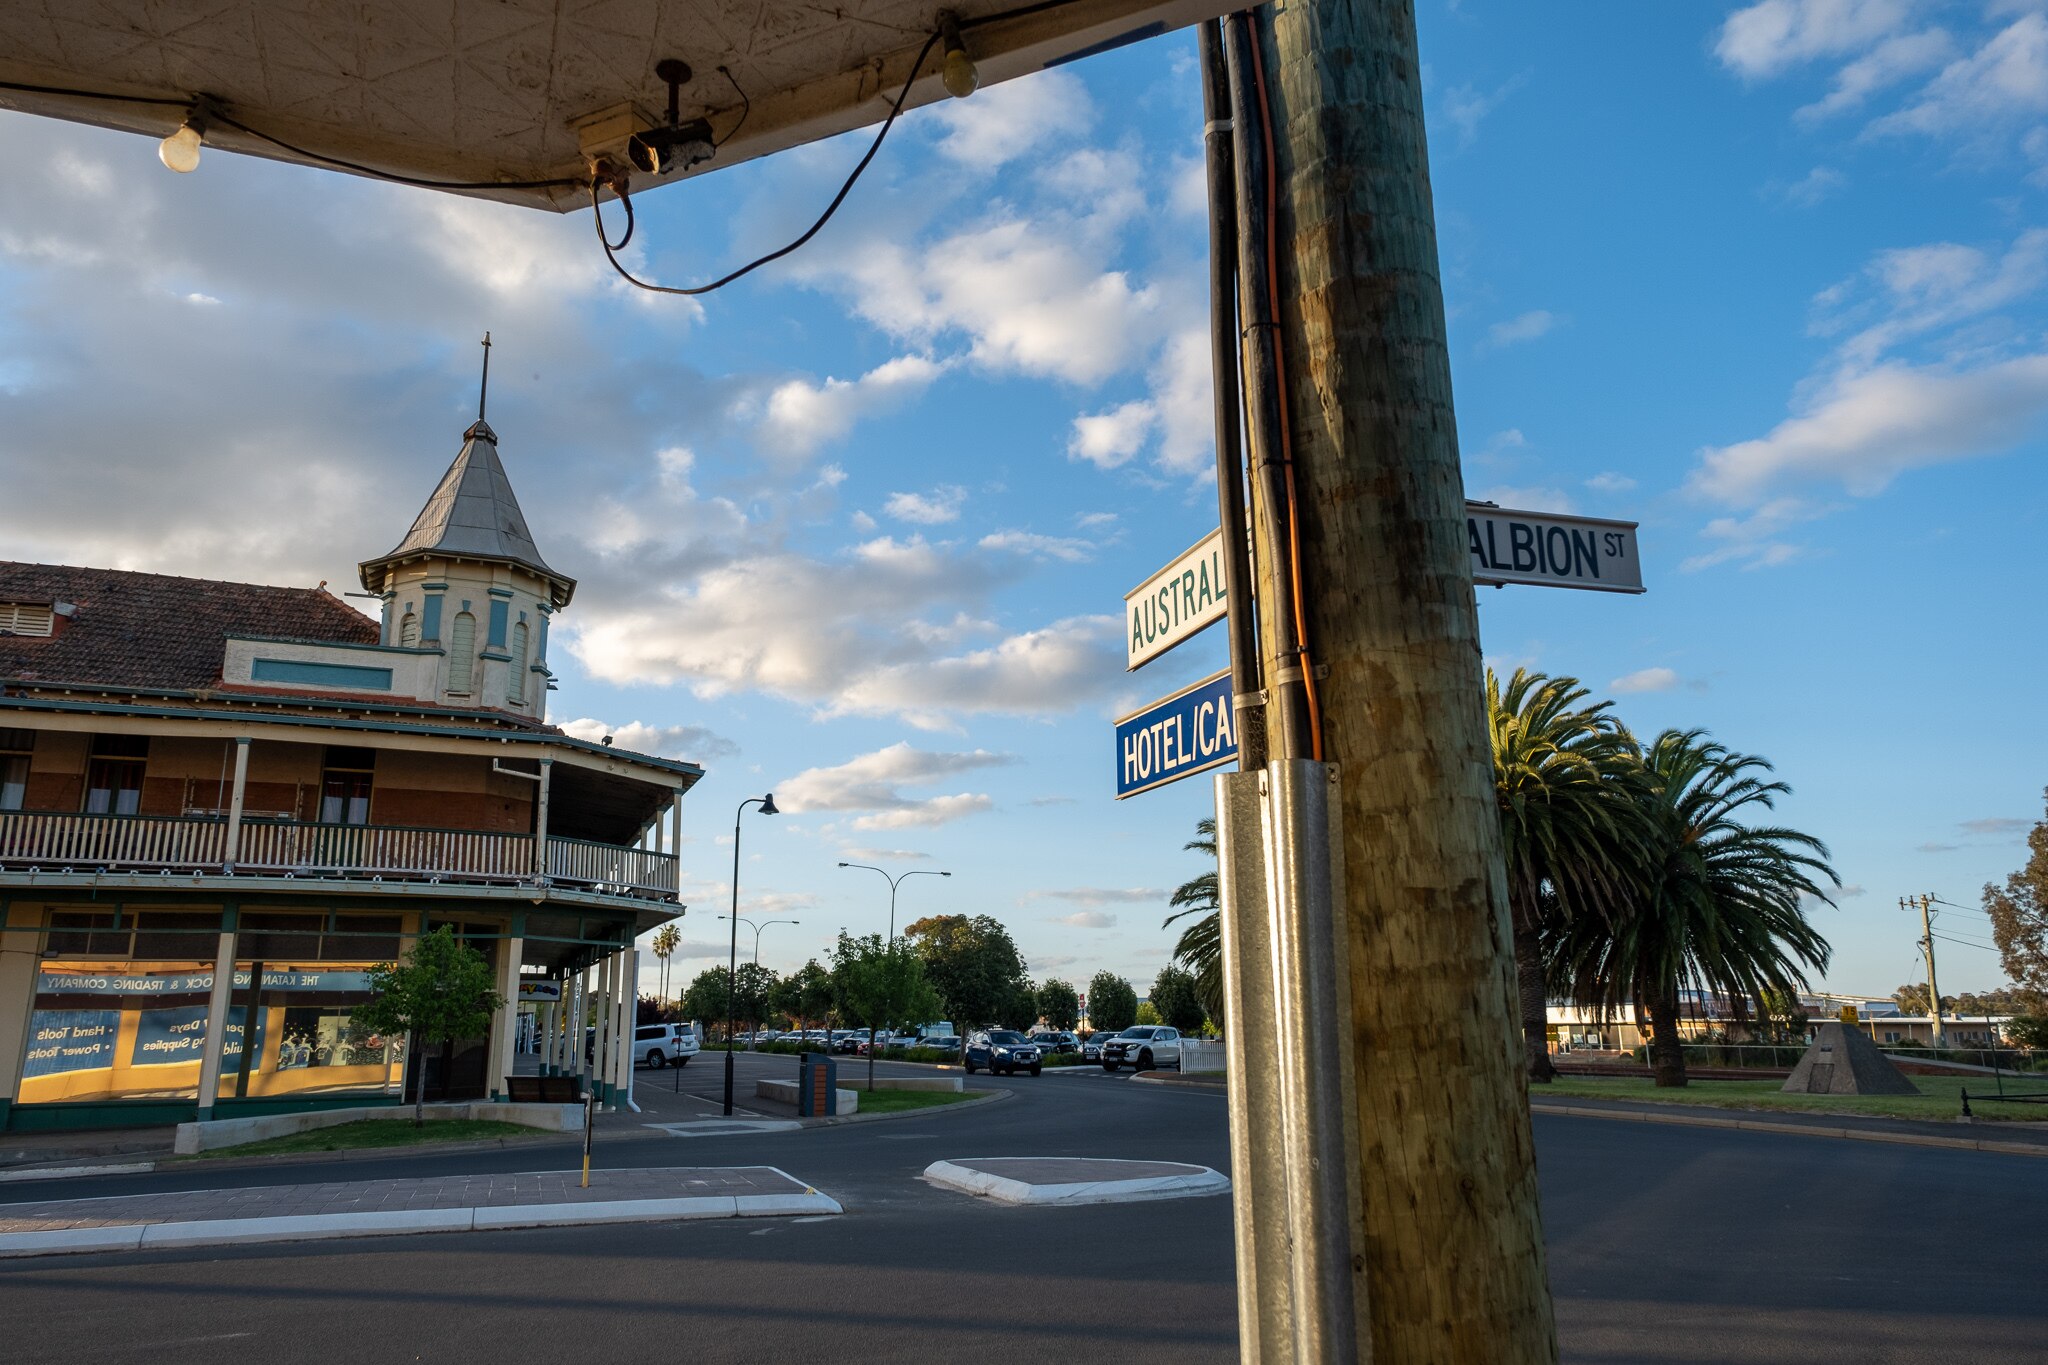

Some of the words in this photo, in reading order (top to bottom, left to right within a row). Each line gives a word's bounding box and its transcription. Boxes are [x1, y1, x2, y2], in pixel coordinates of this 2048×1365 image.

[1467, 518, 1600, 578] ALBION
[1604, 533, 1624, 557] ST
[1132, 551, 1227, 653] AUSTRAL
[1124, 694, 1237, 785] HOTEL/CA
